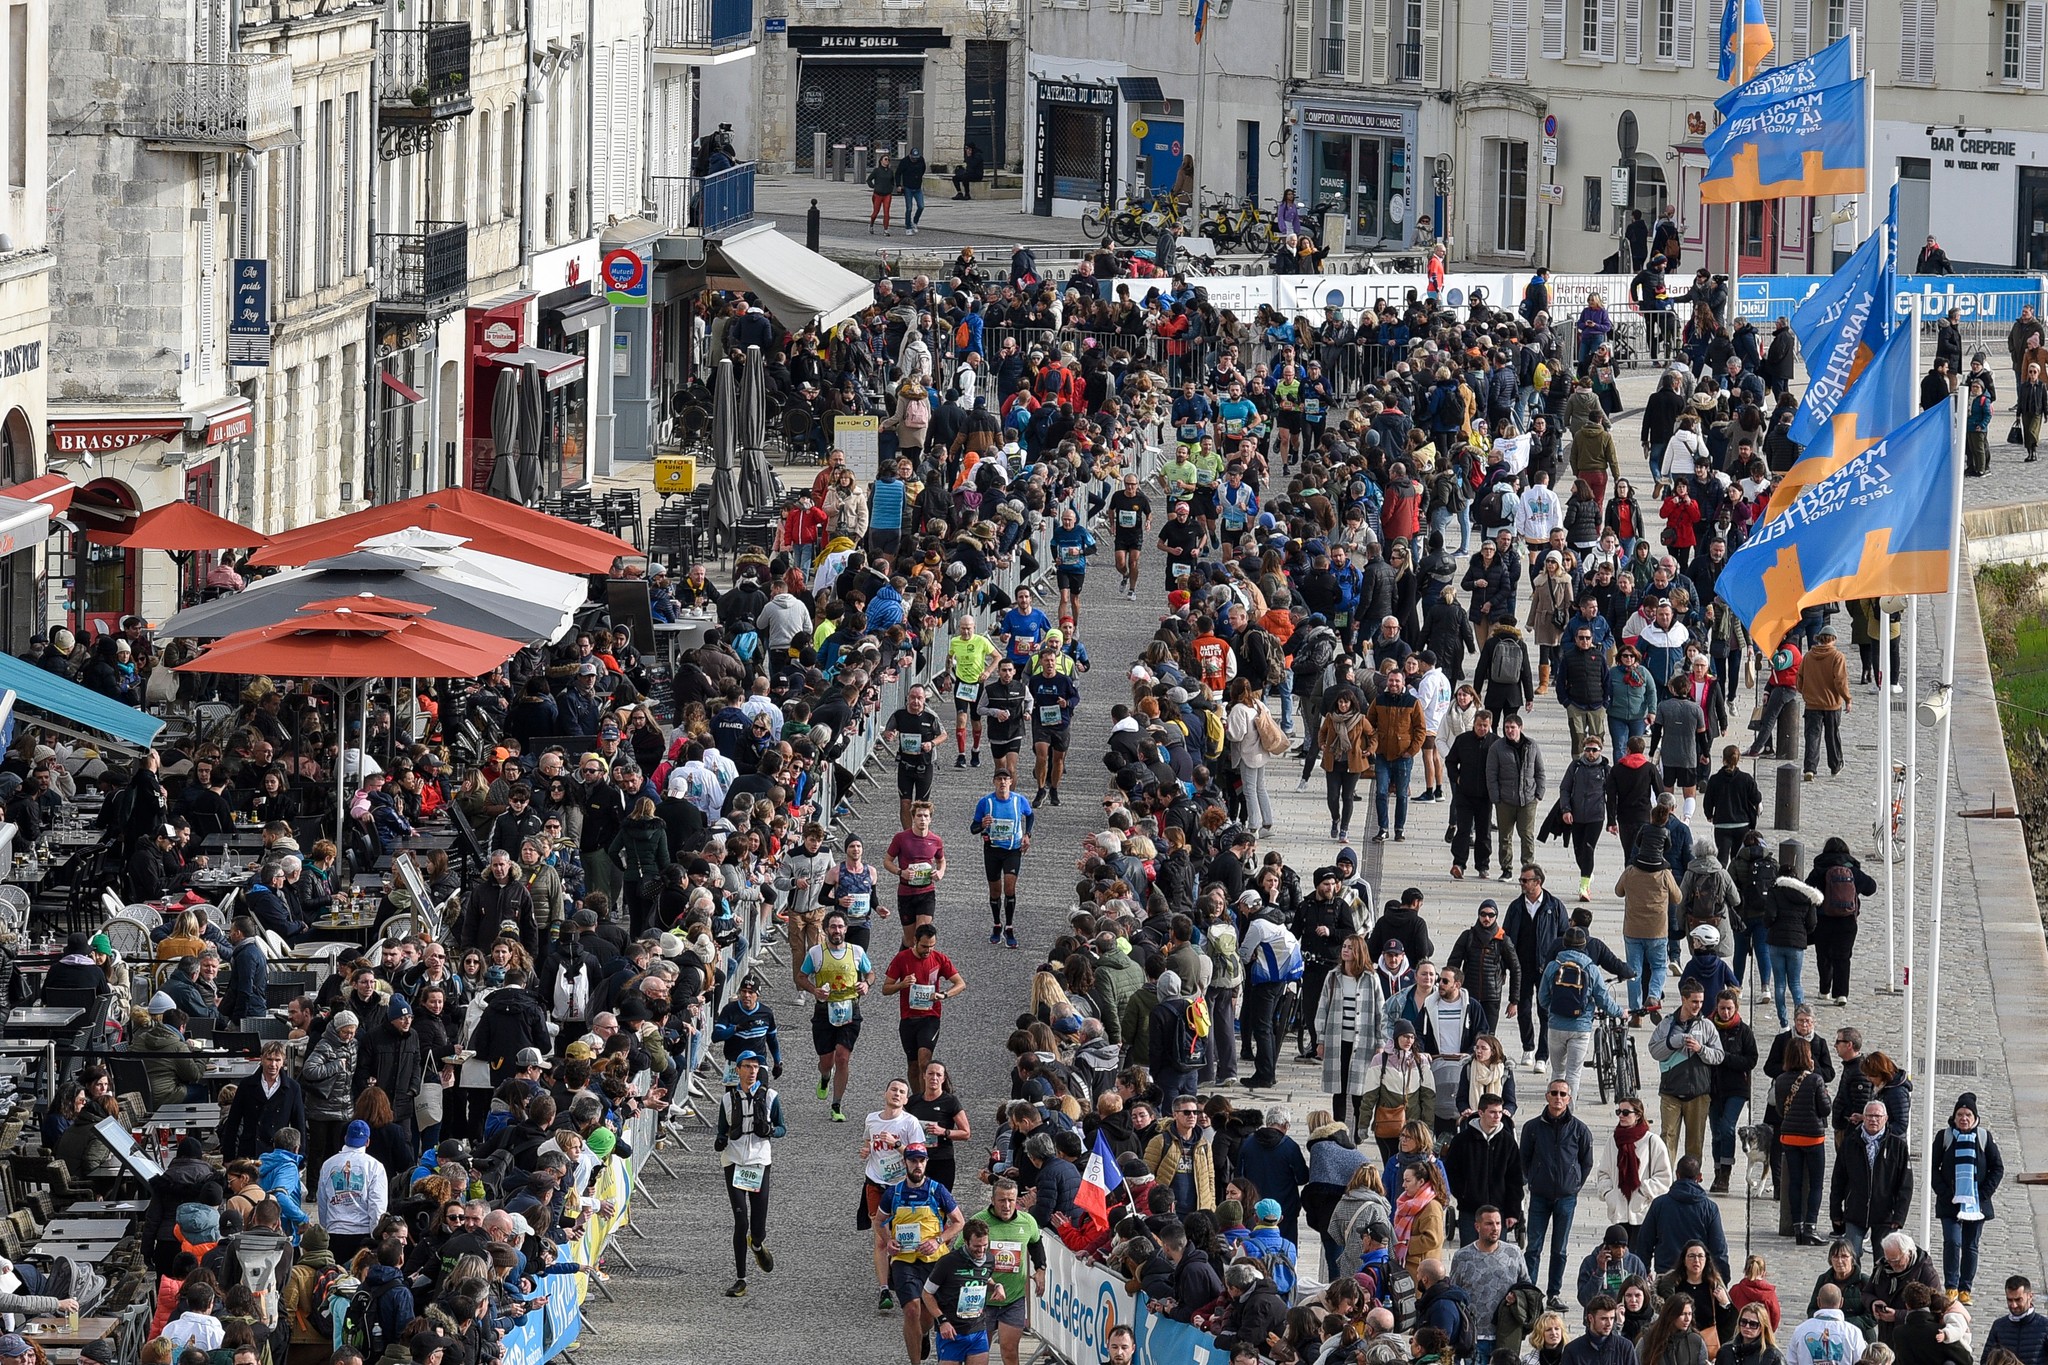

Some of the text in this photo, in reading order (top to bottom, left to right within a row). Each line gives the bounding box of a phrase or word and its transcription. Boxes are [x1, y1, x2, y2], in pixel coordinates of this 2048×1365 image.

[821, 37, 899, 47] PLEIN SOLEIL
[1040, 86, 1113, 104] L'ATELIER DU LINGE
[1305, 111, 1400, 128] COMPTOIR NATIONAL DU CHANGE
[1931, 137, 2016, 156] BAR CREPERIE
[1944, 159, 2000, 171] DU VIEUX PORT
[1320, 177, 1344, 188] CHANGE
[1556, 283, 1608, 294] Harmonie
[915, 991, 929, 1000] 5359
[1049, 1269, 1093, 1347] Leclerc
